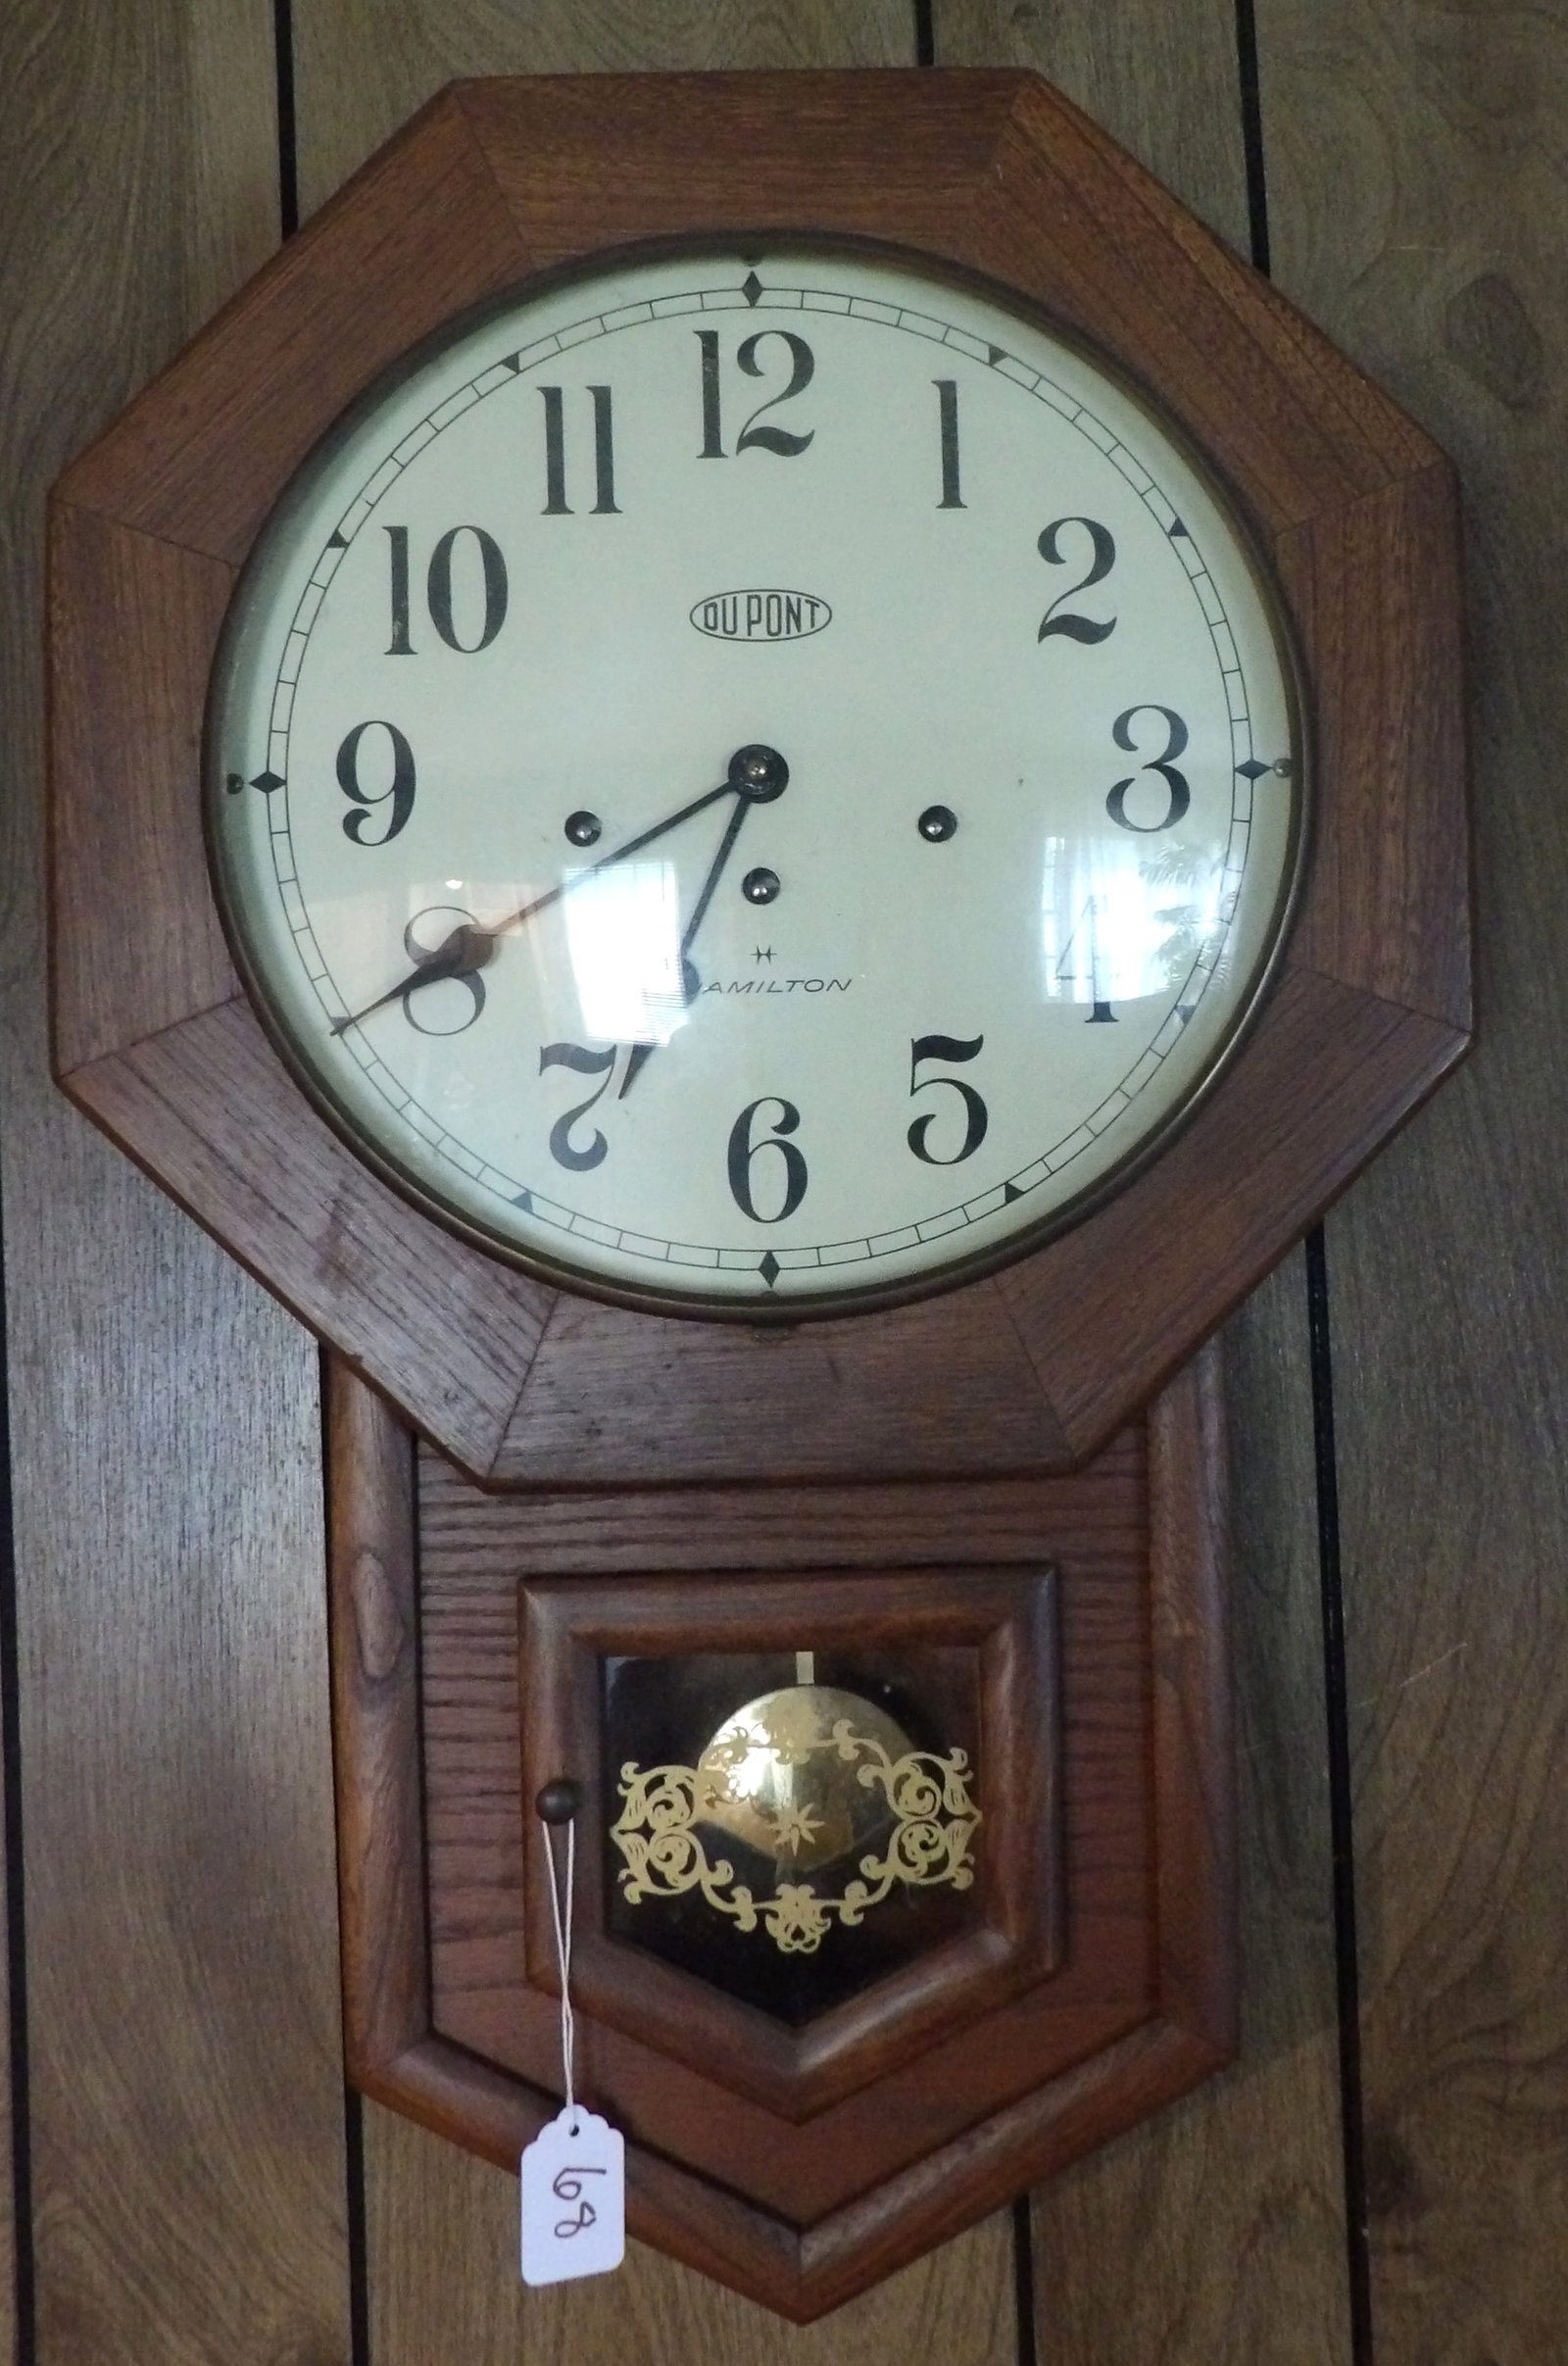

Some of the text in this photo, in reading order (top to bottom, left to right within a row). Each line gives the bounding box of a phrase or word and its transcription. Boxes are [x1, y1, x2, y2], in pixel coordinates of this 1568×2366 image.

[536, 385, 623, 516] 11
[693, 329, 815, 459] 12
[930, 379, 968, 509] 1
[382, 524, 509, 656] 10
[1037, 517, 1117, 645] 2
[335, 719, 416, 847] 9
[1105, 705, 1191, 833] 3
[402, 906, 487, 1036] 8
[702, 979, 853, 994] AMILTON
[1053, 894, 1120, 1023] 4
[539, 1042, 617, 1171] 7
[727, 1097, 808, 1223] 6
[906, 1034, 989, 1165] 5
